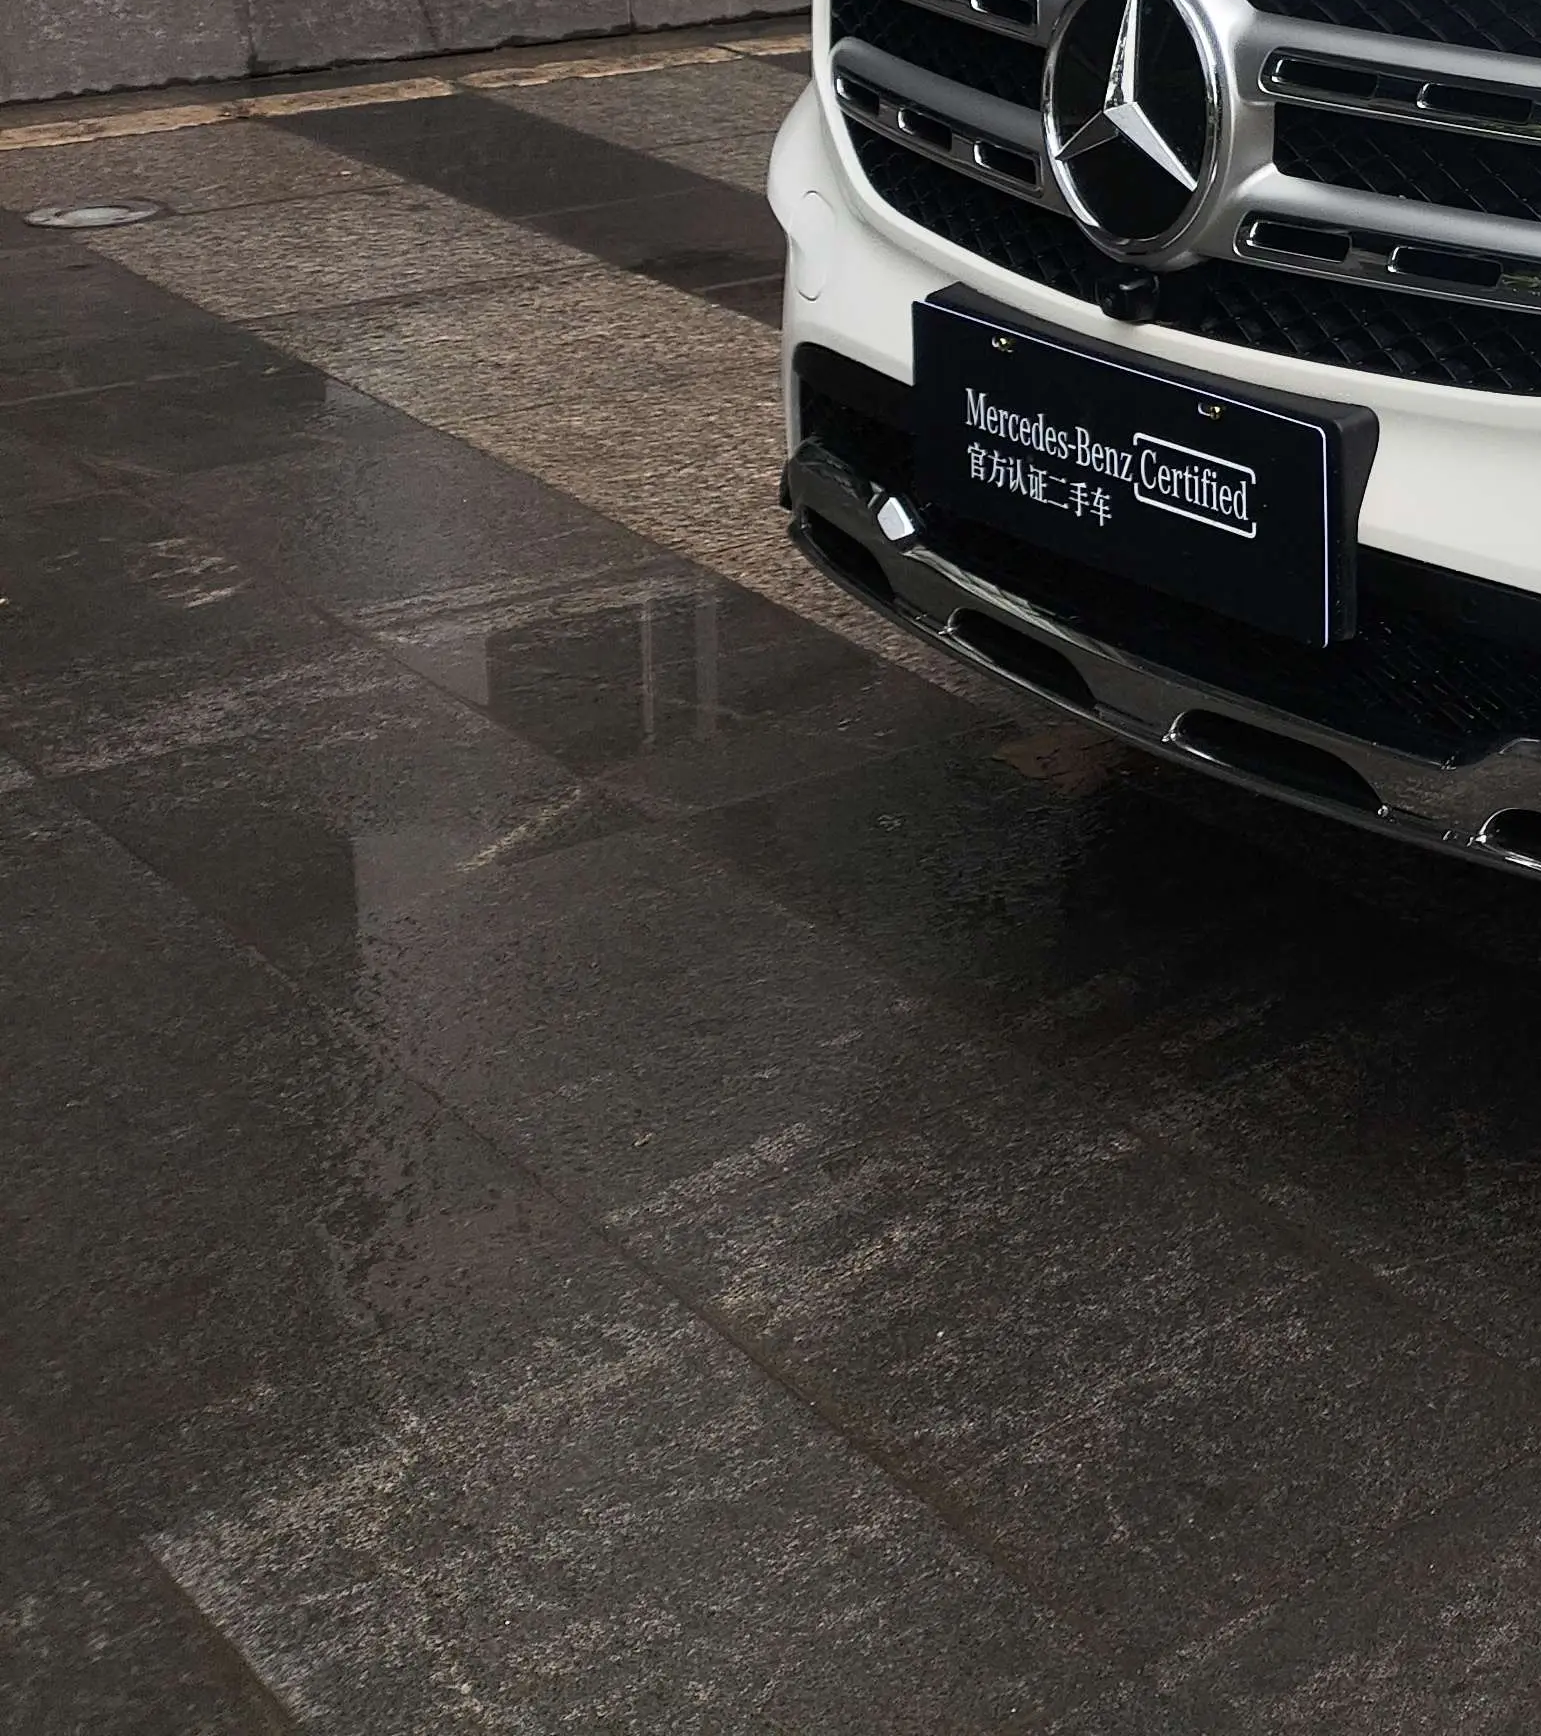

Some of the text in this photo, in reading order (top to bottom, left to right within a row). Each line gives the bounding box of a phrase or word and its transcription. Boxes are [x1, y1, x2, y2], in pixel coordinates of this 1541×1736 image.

[965, 388, 1249, 521] Mercedes-Benz Certified
[967, 442, 1112, 527] 官方认证二手车
